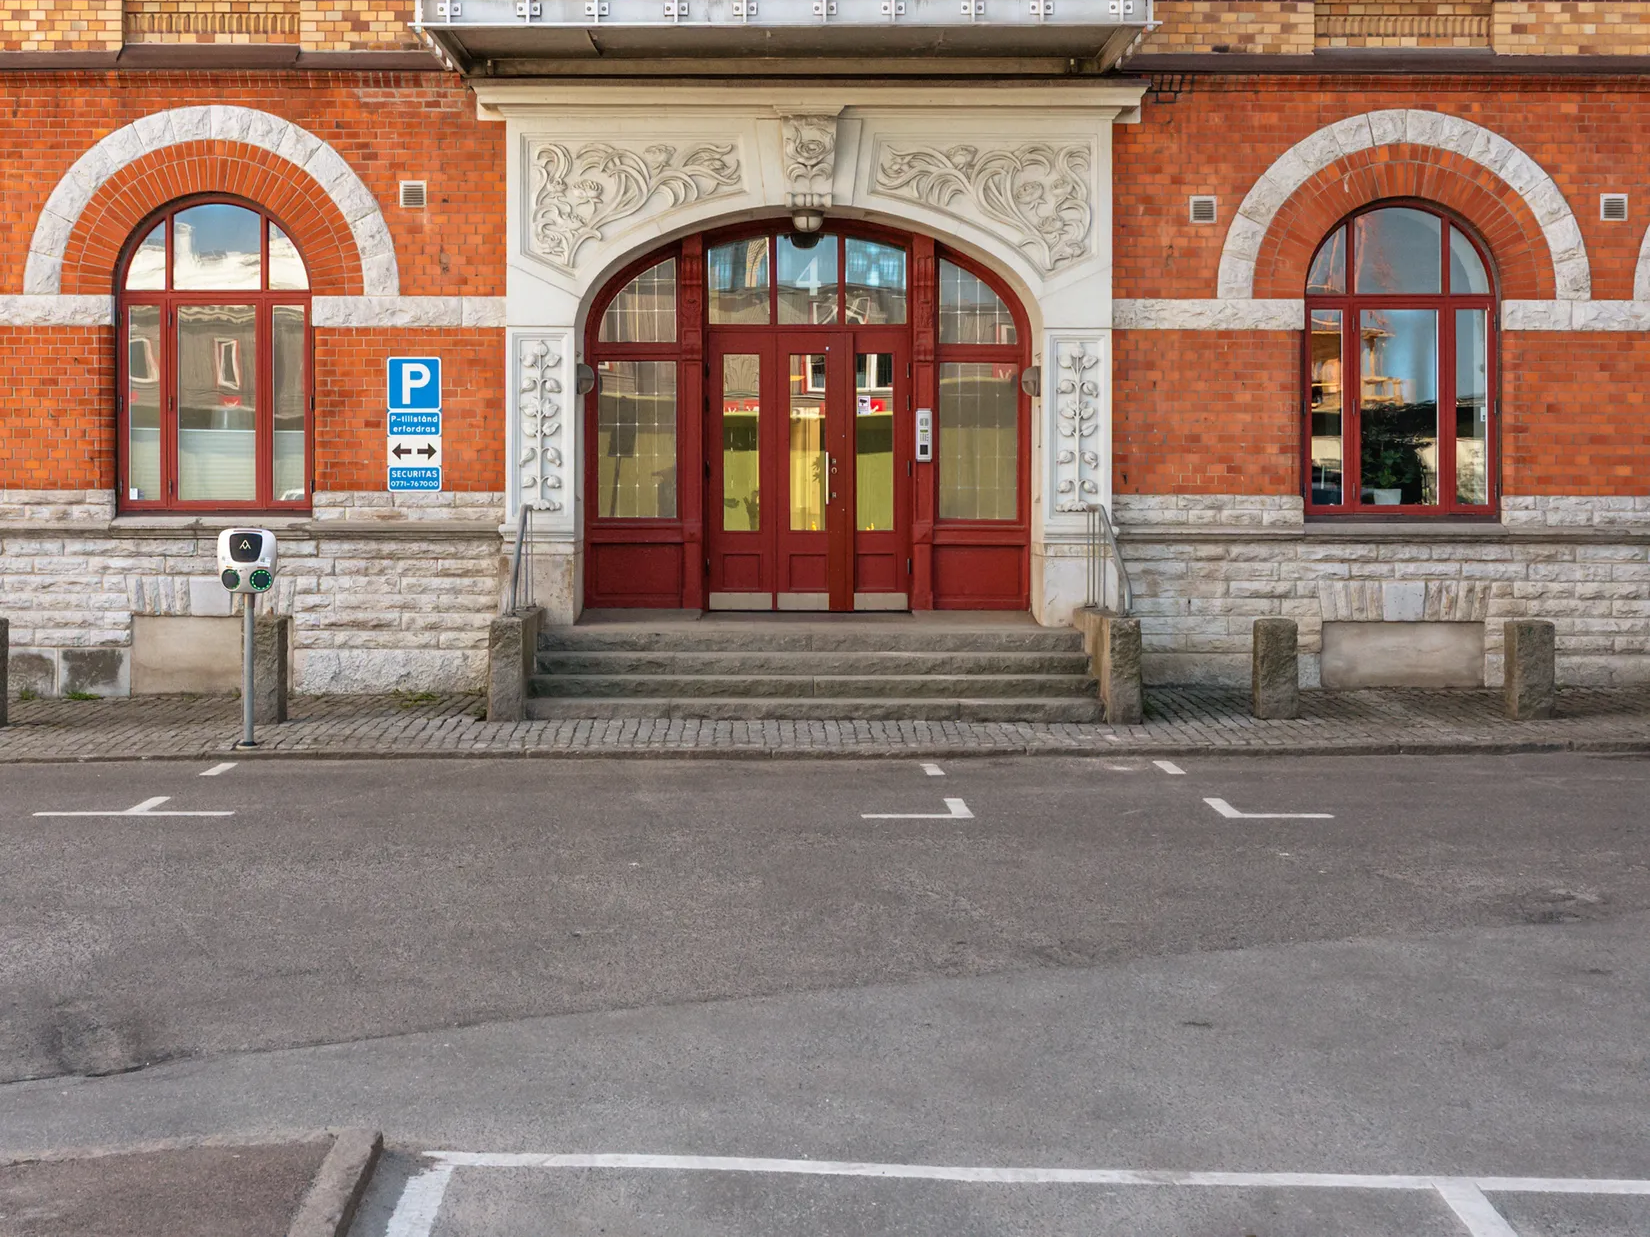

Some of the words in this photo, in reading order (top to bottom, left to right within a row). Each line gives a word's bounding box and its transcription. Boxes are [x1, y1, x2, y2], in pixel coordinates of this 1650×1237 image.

[796, 256, 822, 296] 4
[402, 363, 431, 405] P
[391, 415, 438, 423] P-tillstånd
[393, 425, 436, 433] erfordras
[391, 470, 438, 478] SECURITAS
